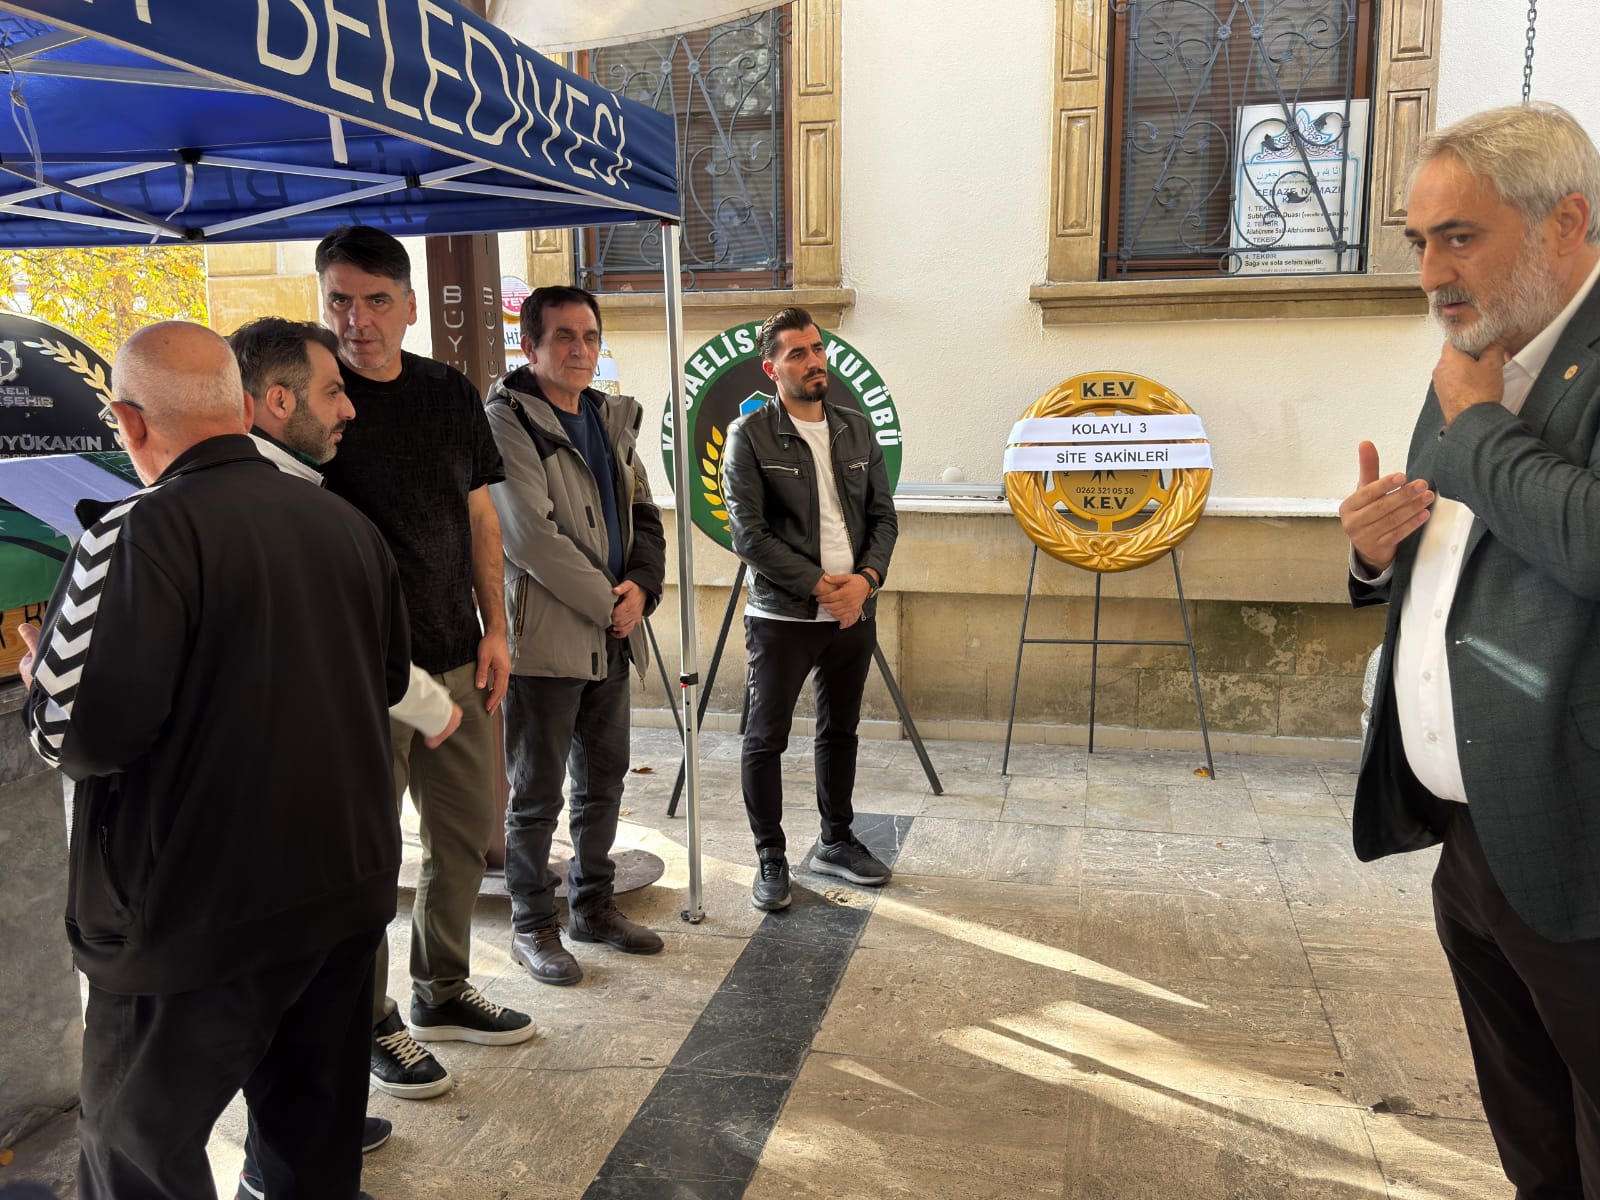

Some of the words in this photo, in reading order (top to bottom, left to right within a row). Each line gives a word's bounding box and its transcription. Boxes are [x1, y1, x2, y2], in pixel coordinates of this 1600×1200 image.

[825, 339, 903, 447] KULÜBÜ
[1072, 423, 1132, 435] KOLAYLI
[1139, 422, 1147, 433] 3
[1056, 451, 1087, 464] SİTE
[1094, 448, 1169, 463] SAKİNLERİ
